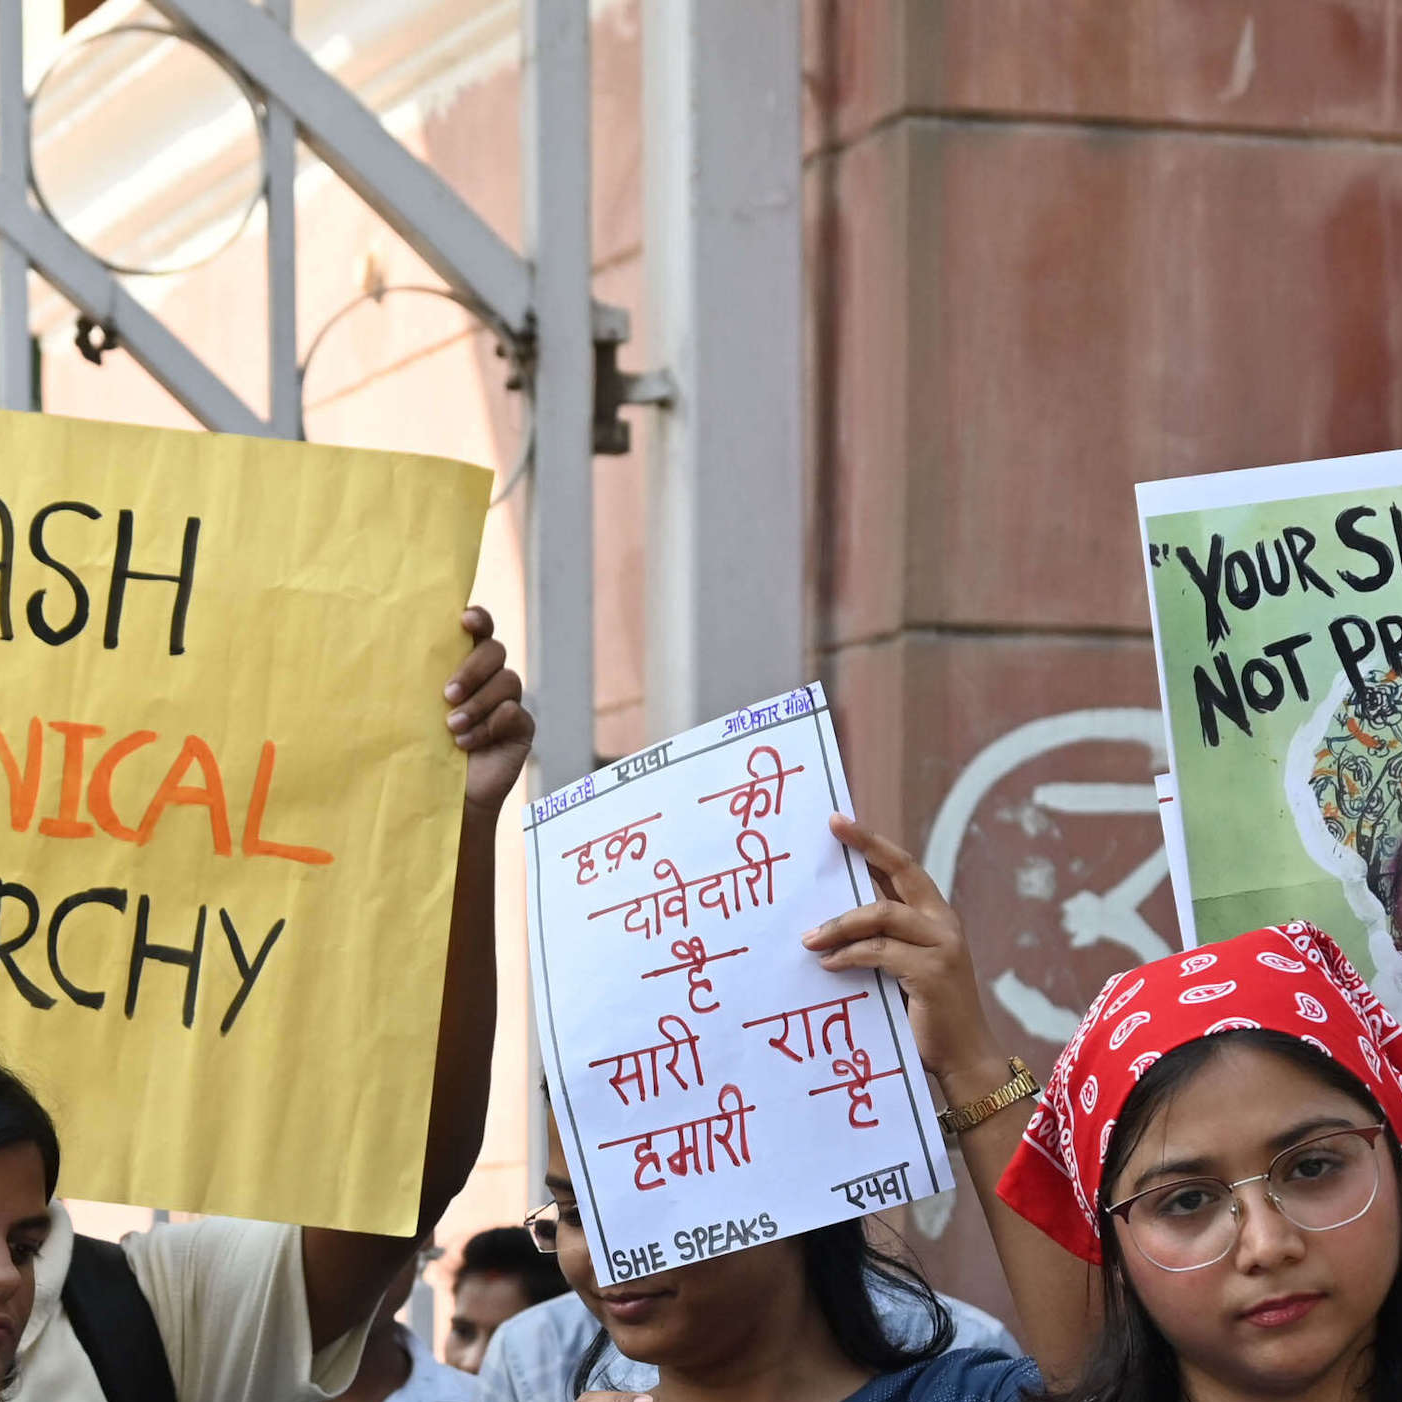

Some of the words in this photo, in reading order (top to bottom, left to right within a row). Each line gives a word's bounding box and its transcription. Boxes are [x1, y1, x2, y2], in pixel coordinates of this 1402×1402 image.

[1192, 632, 1313, 748] NOT
[697, 745, 805, 828] की
[587, 829, 791, 940] दावेदारी
[640, 935, 749, 1014] है
[589, 1015, 700, 1106] सारी
[741, 991, 870, 1064] रात
[597, 1083, 757, 1192] हमारी
[808, 1048, 905, 1130] है
[611, 1241, 667, 1281] SHE
[673, 1211, 779, 1261] SPEAKS
